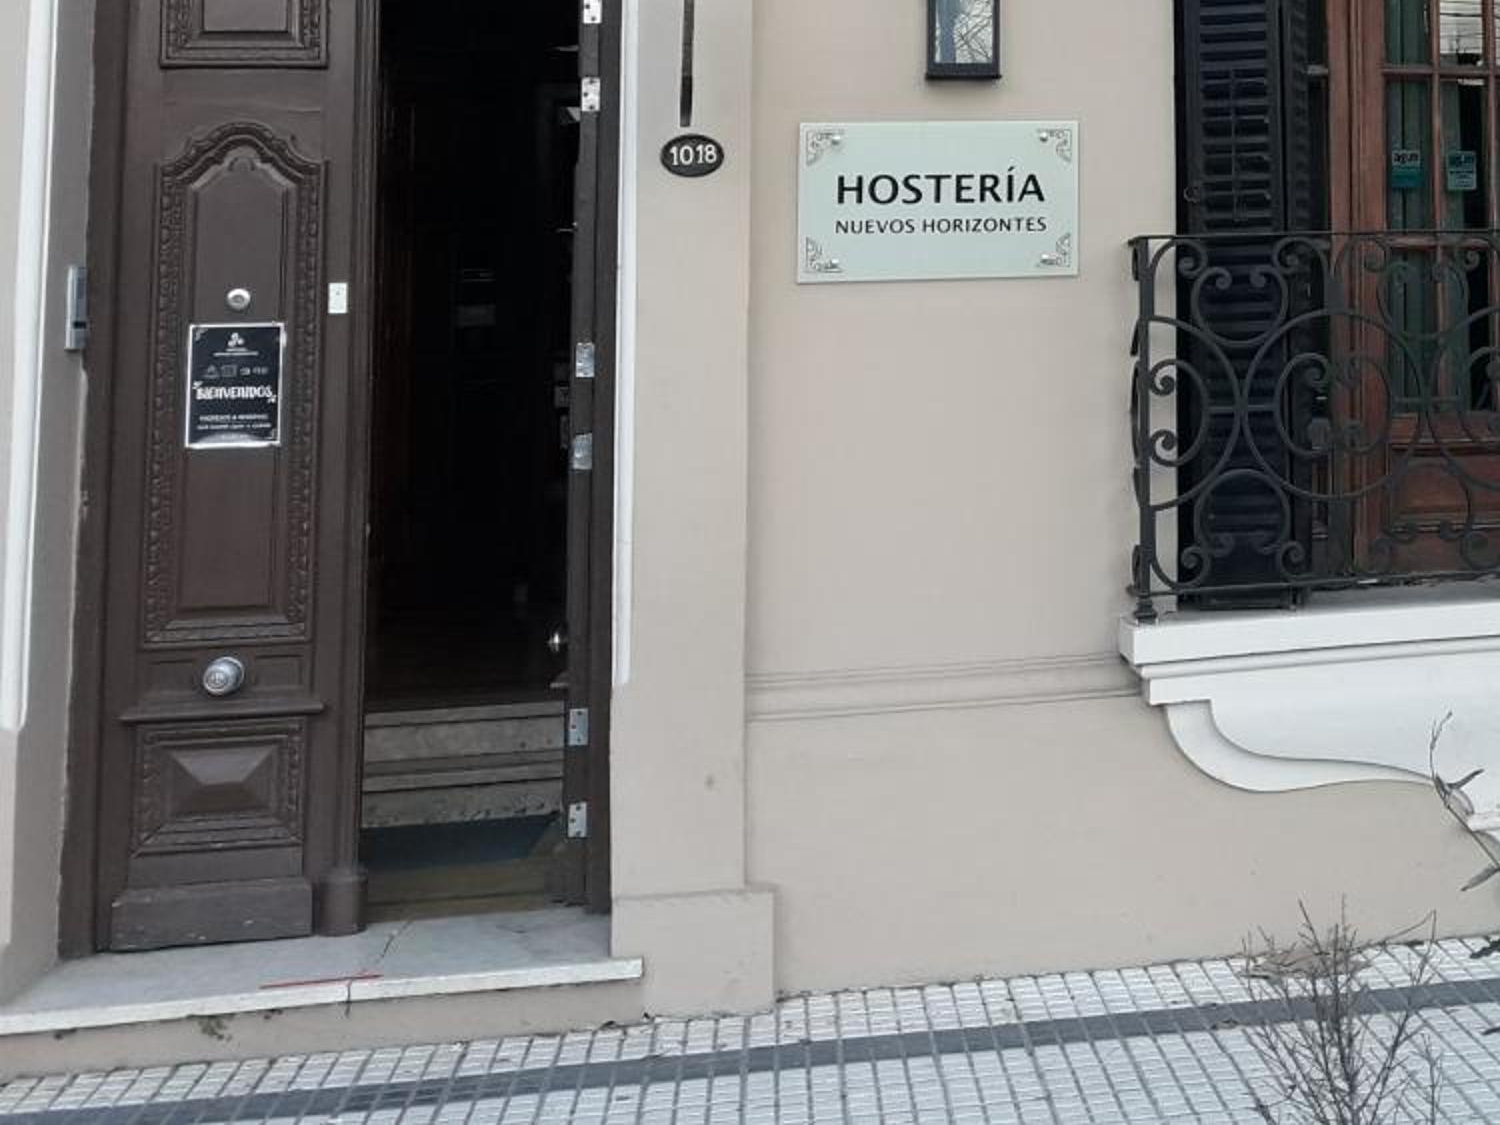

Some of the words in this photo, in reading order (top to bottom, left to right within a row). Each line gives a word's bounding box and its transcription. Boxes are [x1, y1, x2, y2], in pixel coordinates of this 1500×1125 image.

[669, 143, 717, 166] 1018
[836, 166, 1046, 205] HOSTERÍA
[835, 218, 916, 235] NUEVOS
[922, 216, 1048, 234] HORIZONTES
